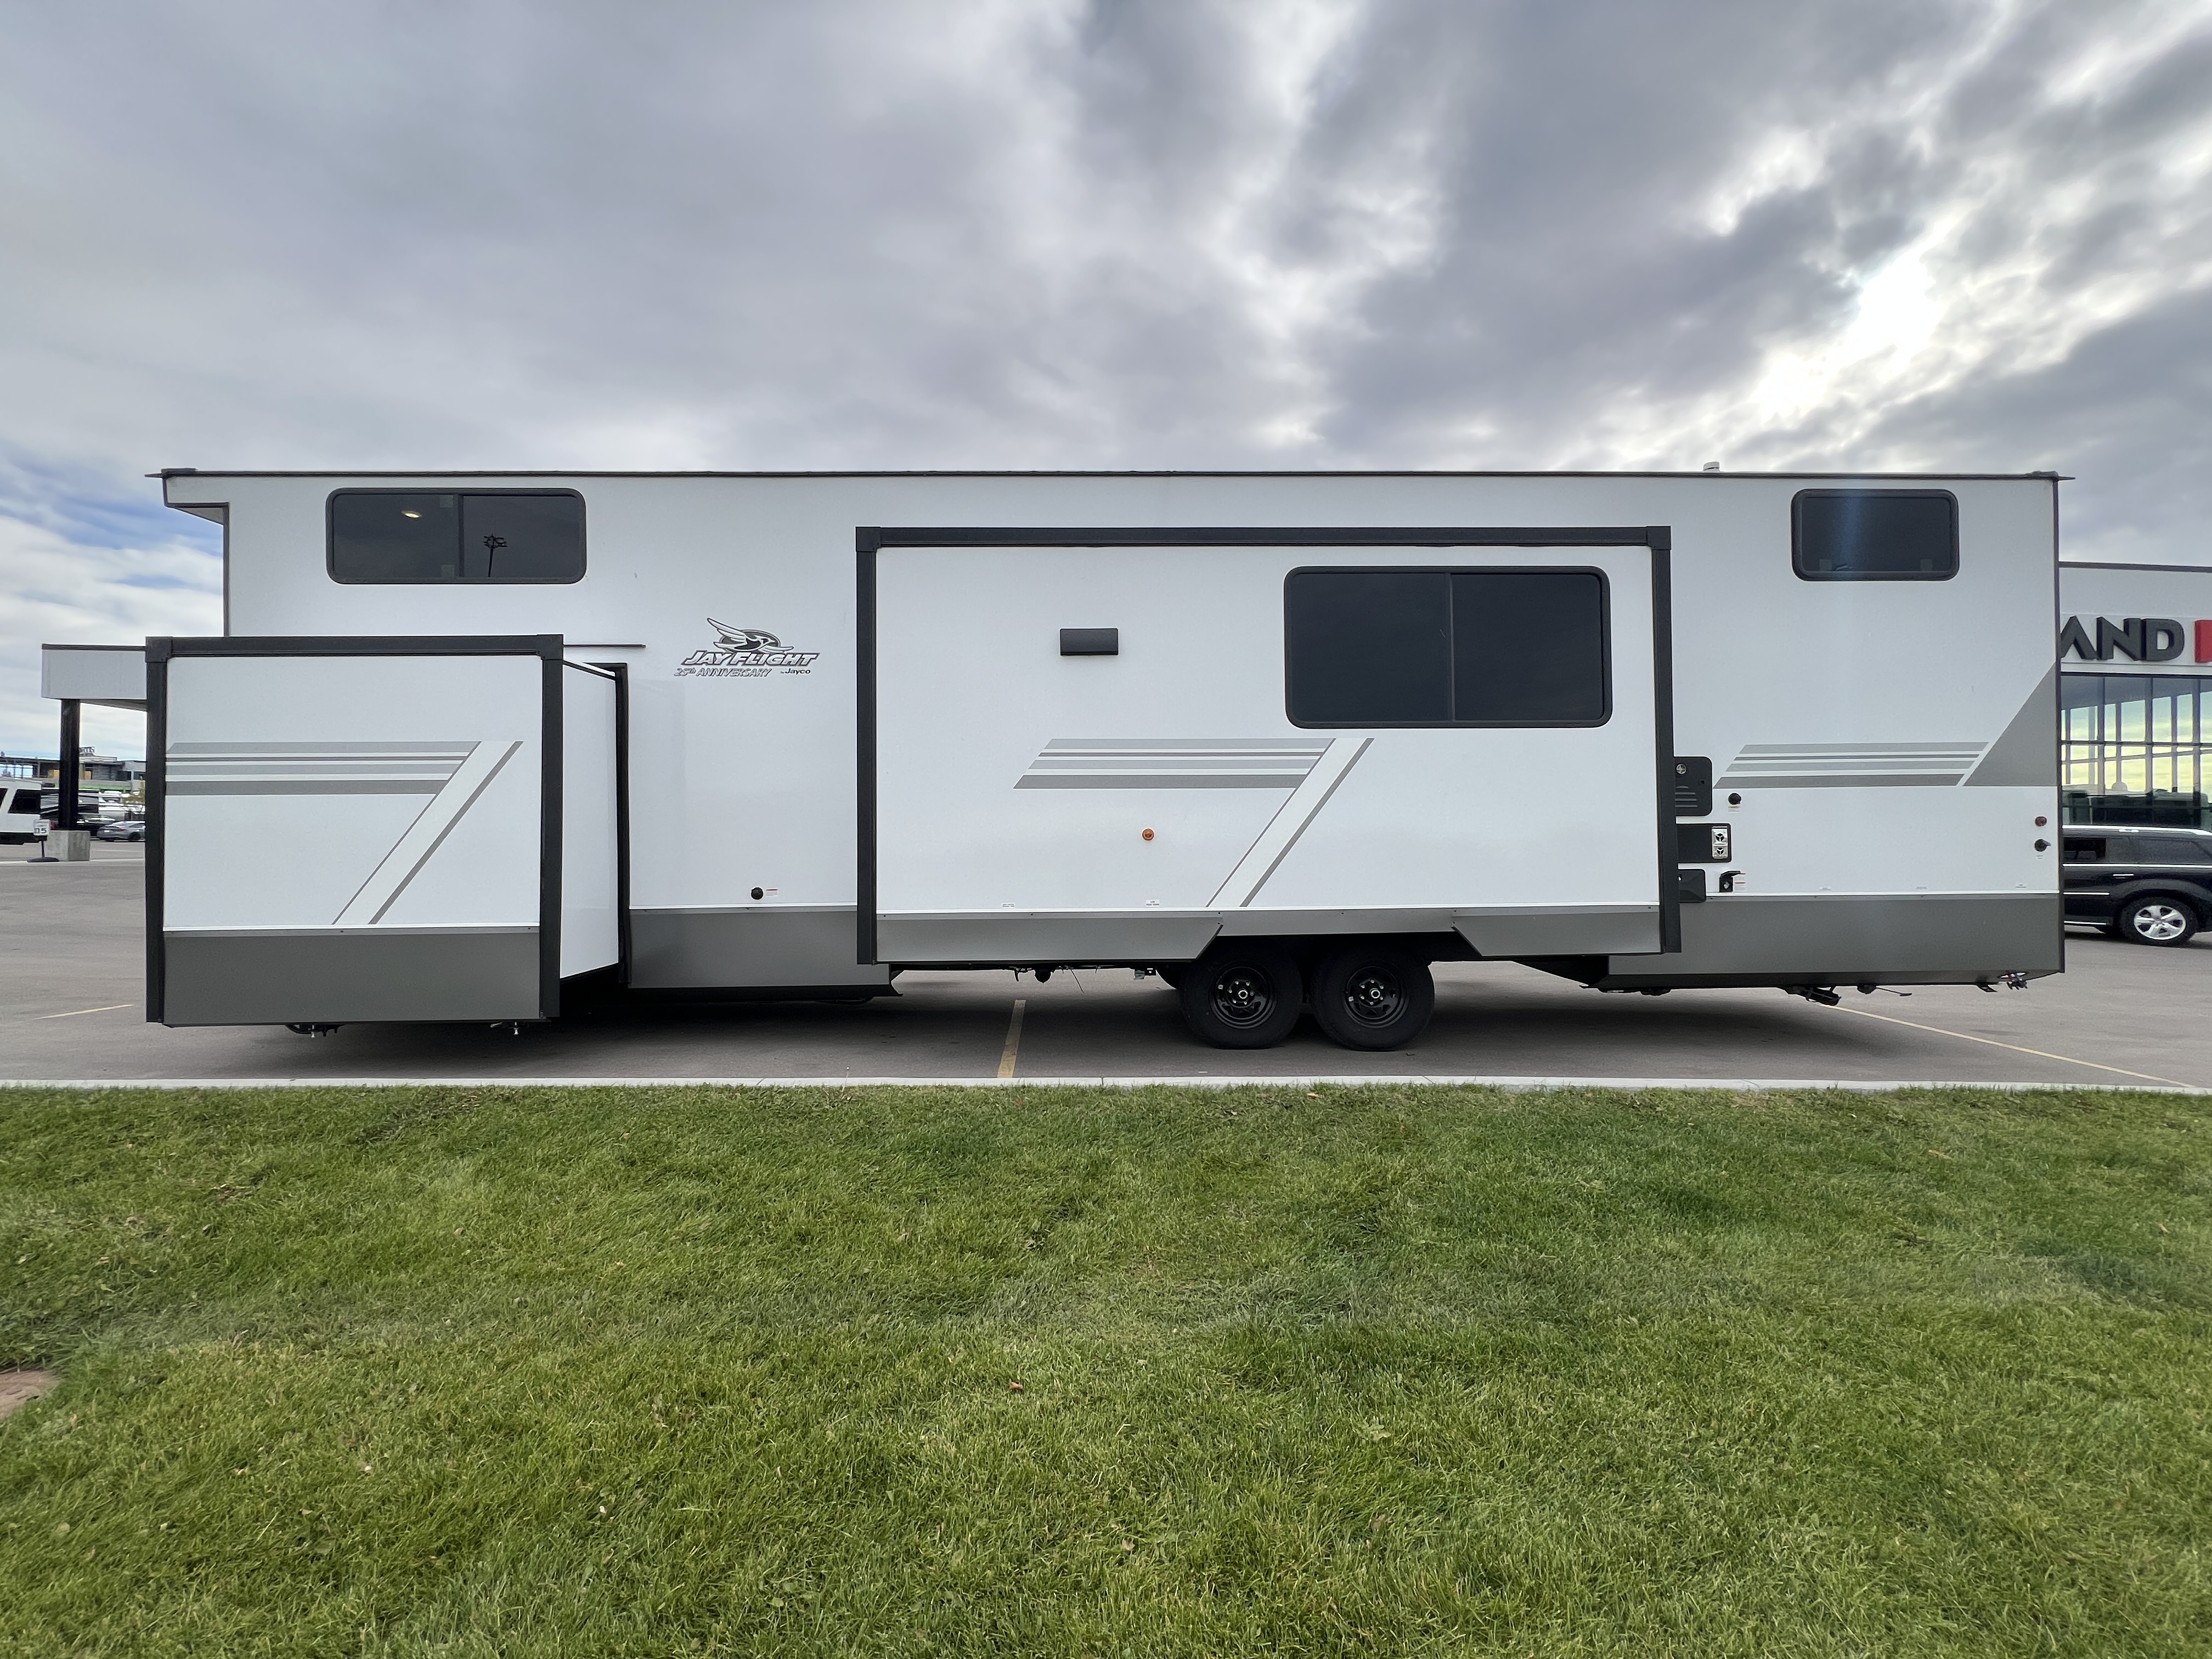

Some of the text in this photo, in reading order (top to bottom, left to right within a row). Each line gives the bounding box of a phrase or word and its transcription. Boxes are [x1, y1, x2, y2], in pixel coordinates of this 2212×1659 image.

[681, 650, 820, 667] JAY FLIGHT
[674, 668, 772, 677] 25th ANNIVERSARY
